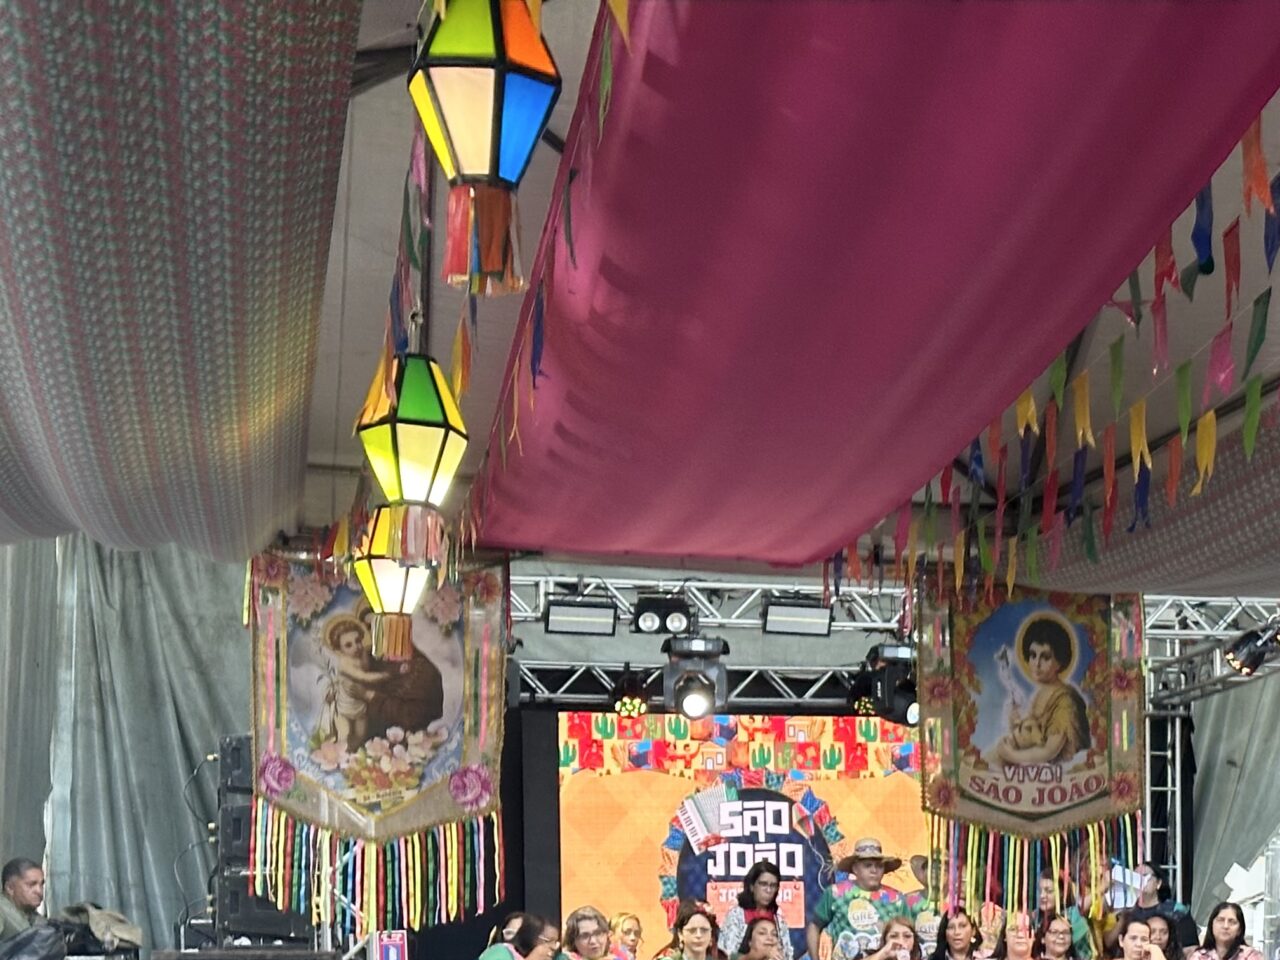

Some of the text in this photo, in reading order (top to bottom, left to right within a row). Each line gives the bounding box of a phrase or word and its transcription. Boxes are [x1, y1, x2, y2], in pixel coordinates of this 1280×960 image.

[1003, 764, 1063, 783] VIVA!
[969, 774, 1106, 807] SÃO JOÃO
[719, 800, 789, 842] SÃO
